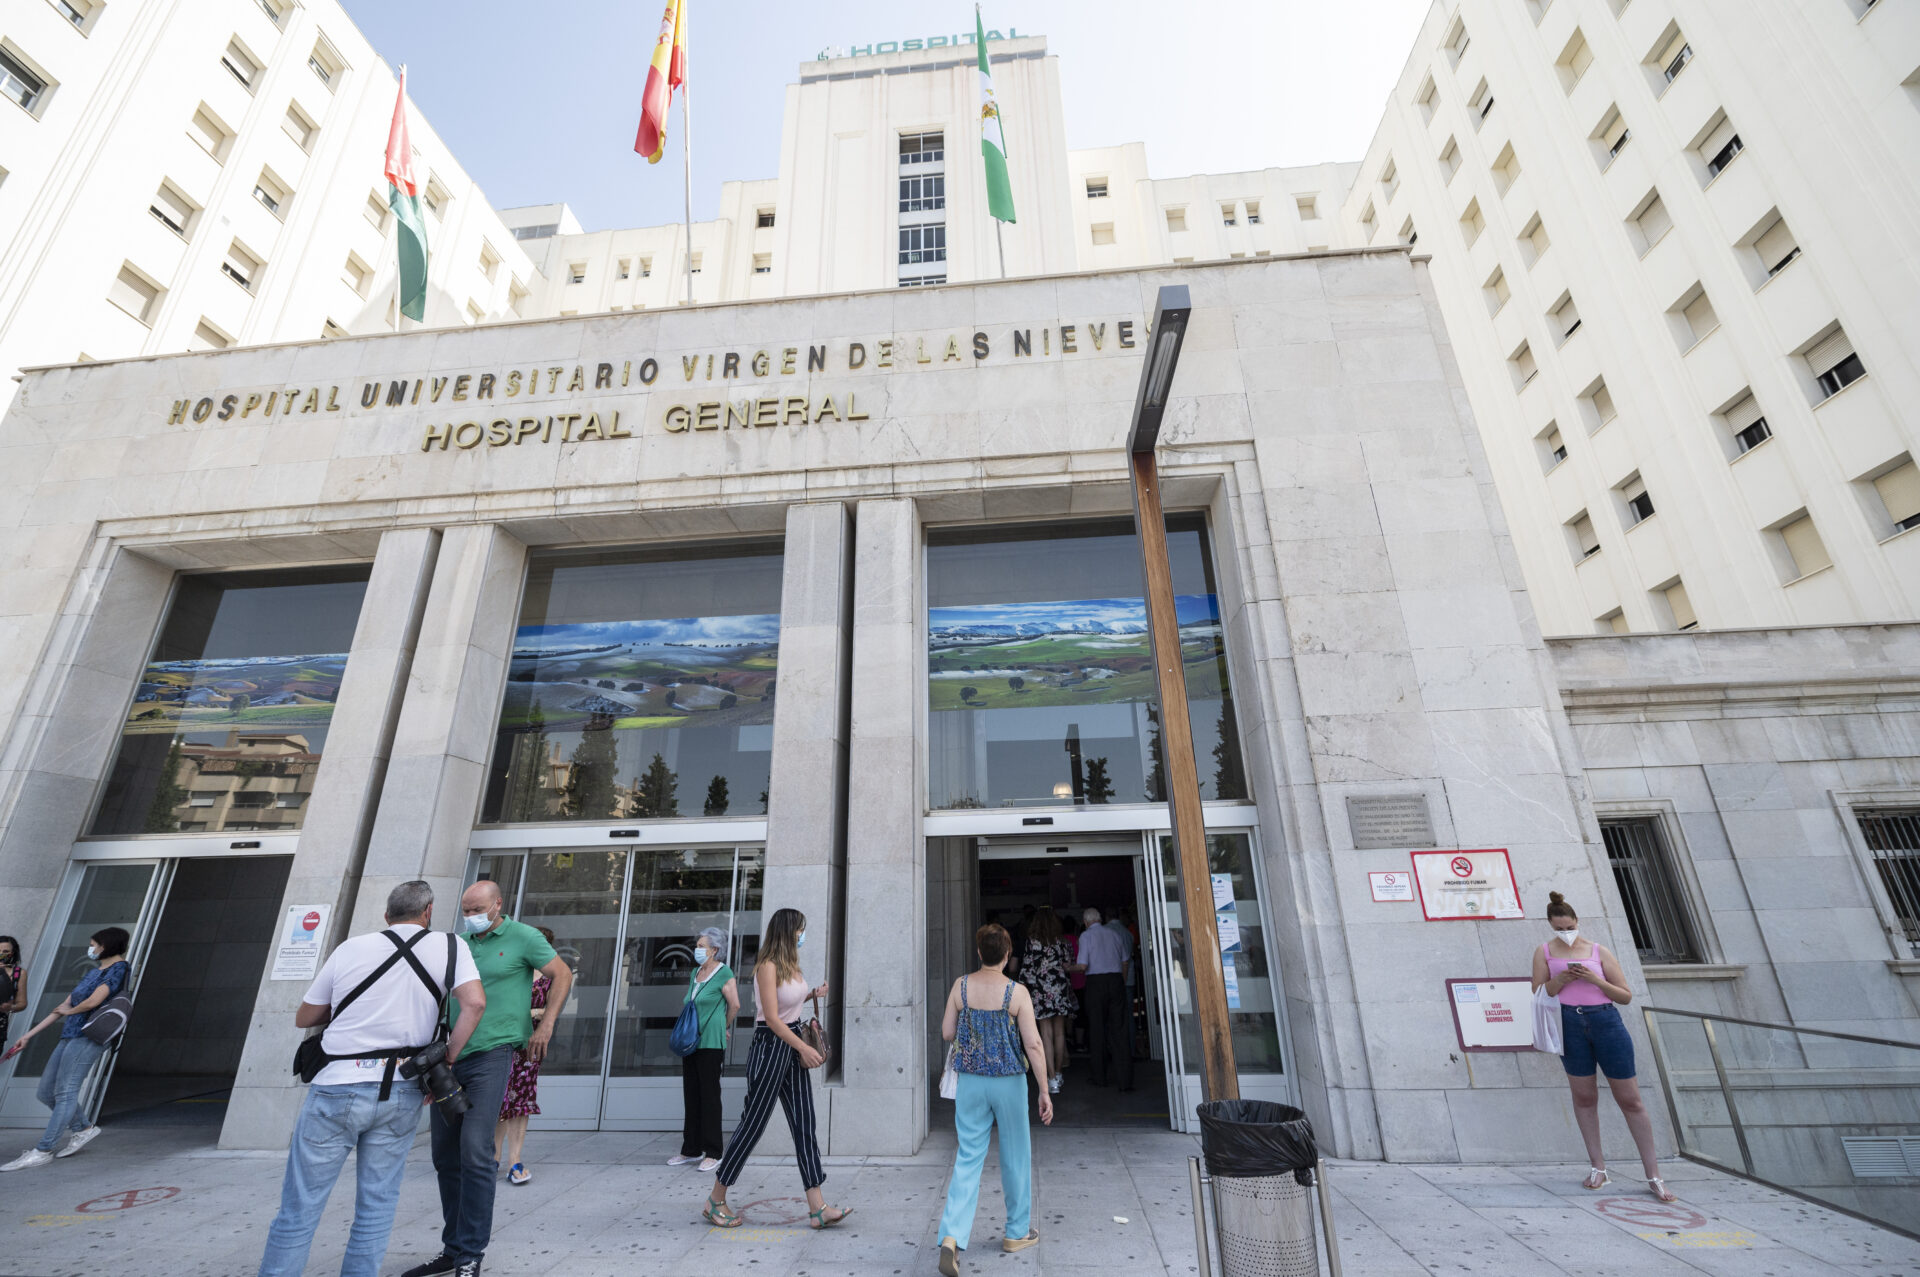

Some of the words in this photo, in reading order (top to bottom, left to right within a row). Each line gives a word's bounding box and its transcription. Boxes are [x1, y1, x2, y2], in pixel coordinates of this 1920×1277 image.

[851, 27, 1029, 58] HOSPITAL
[168, 386, 340, 426] HOSPITAL
[360, 358, 660, 409] UNIVERSITARIO
[682, 344, 827, 382] VIRGEN
[848, 339, 894, 369] DE
[916, 332, 990, 364] LAS
[1013, 318, 1153, 357] NIEVE
[421, 409, 633, 453] HOSPITAL
[661, 392, 870, 433] GENERAL
